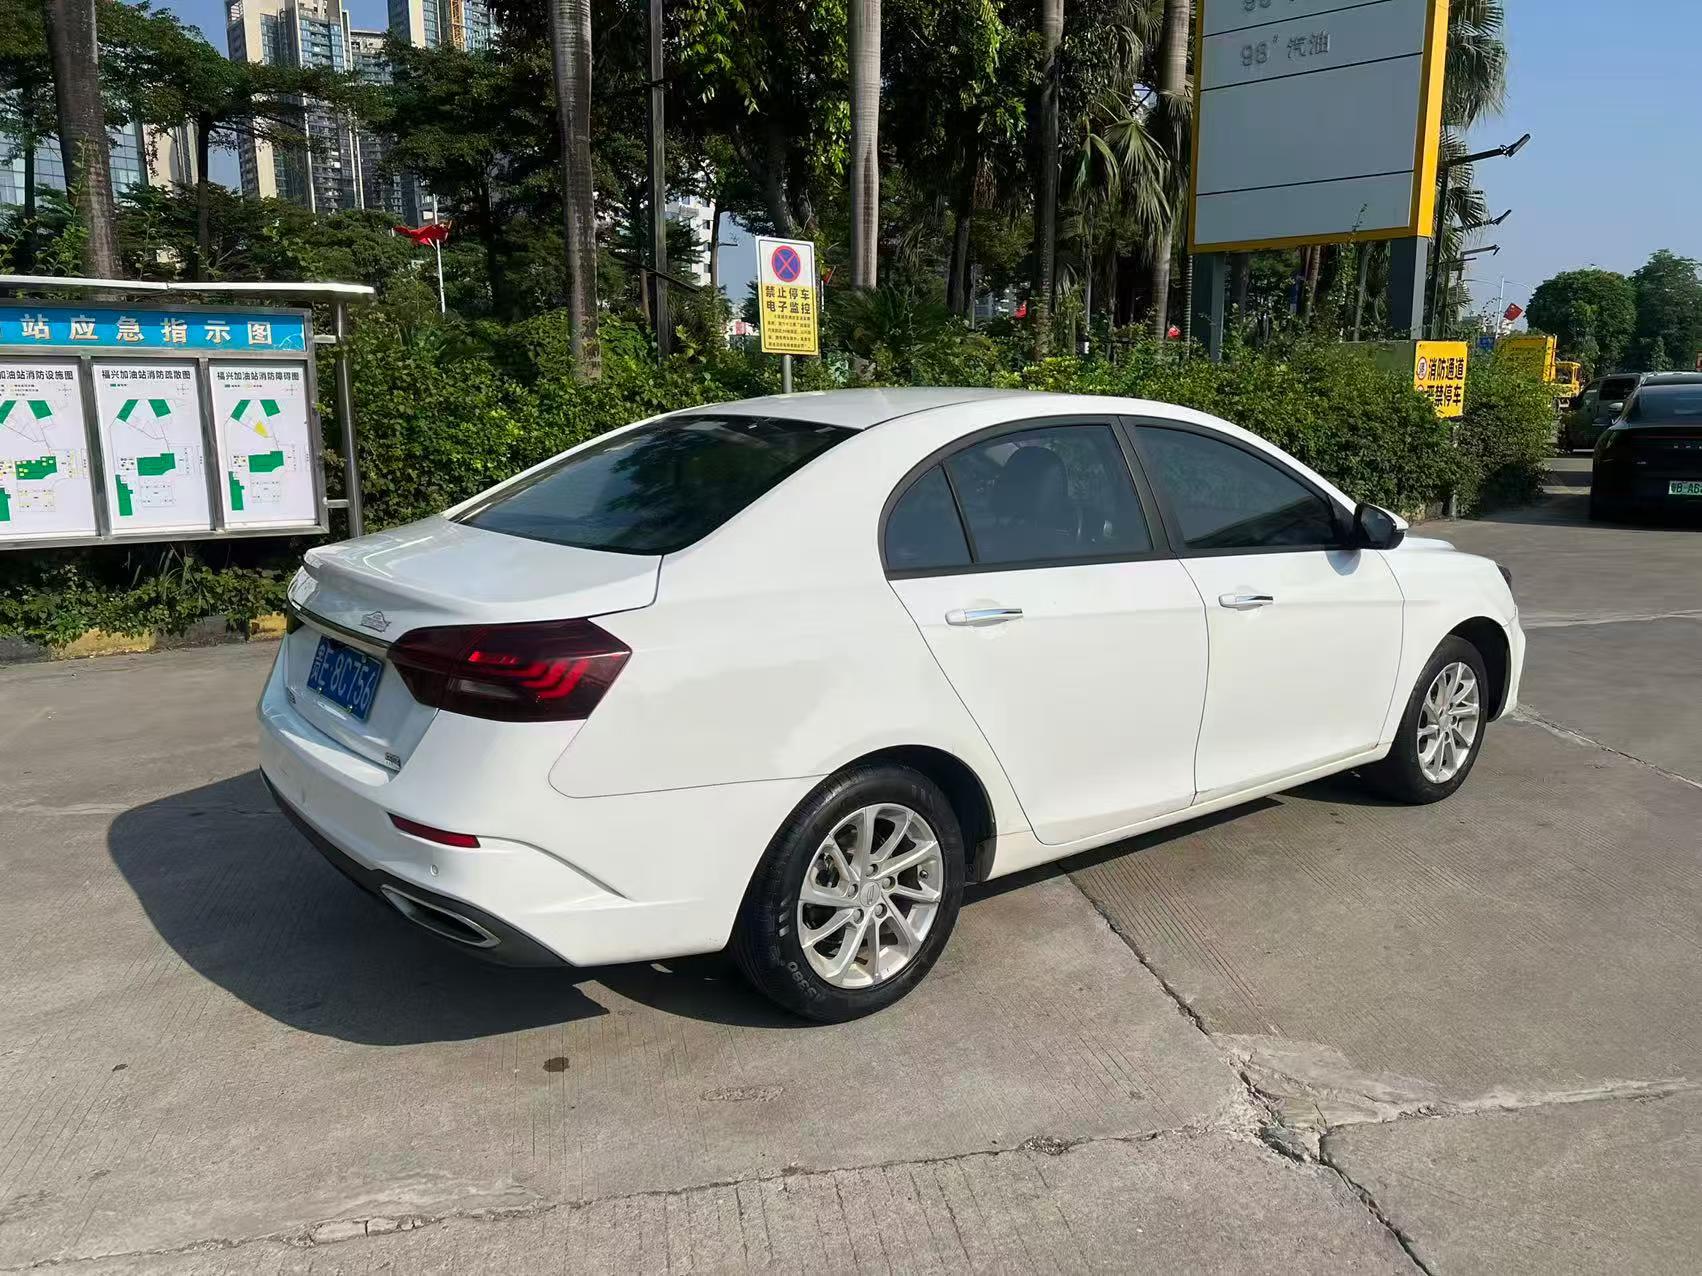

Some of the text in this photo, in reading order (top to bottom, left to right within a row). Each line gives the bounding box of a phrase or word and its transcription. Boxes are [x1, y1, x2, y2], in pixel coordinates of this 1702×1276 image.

[765, 285, 810, 301] 禁止停车
[766, 300, 811, 315] 电子监控
[20, 313, 272, 345] 站应急指示图
[101, 369, 191, 381] 福兴加油站消防疏散图
[1427, 357, 1464, 381] 消防通道
